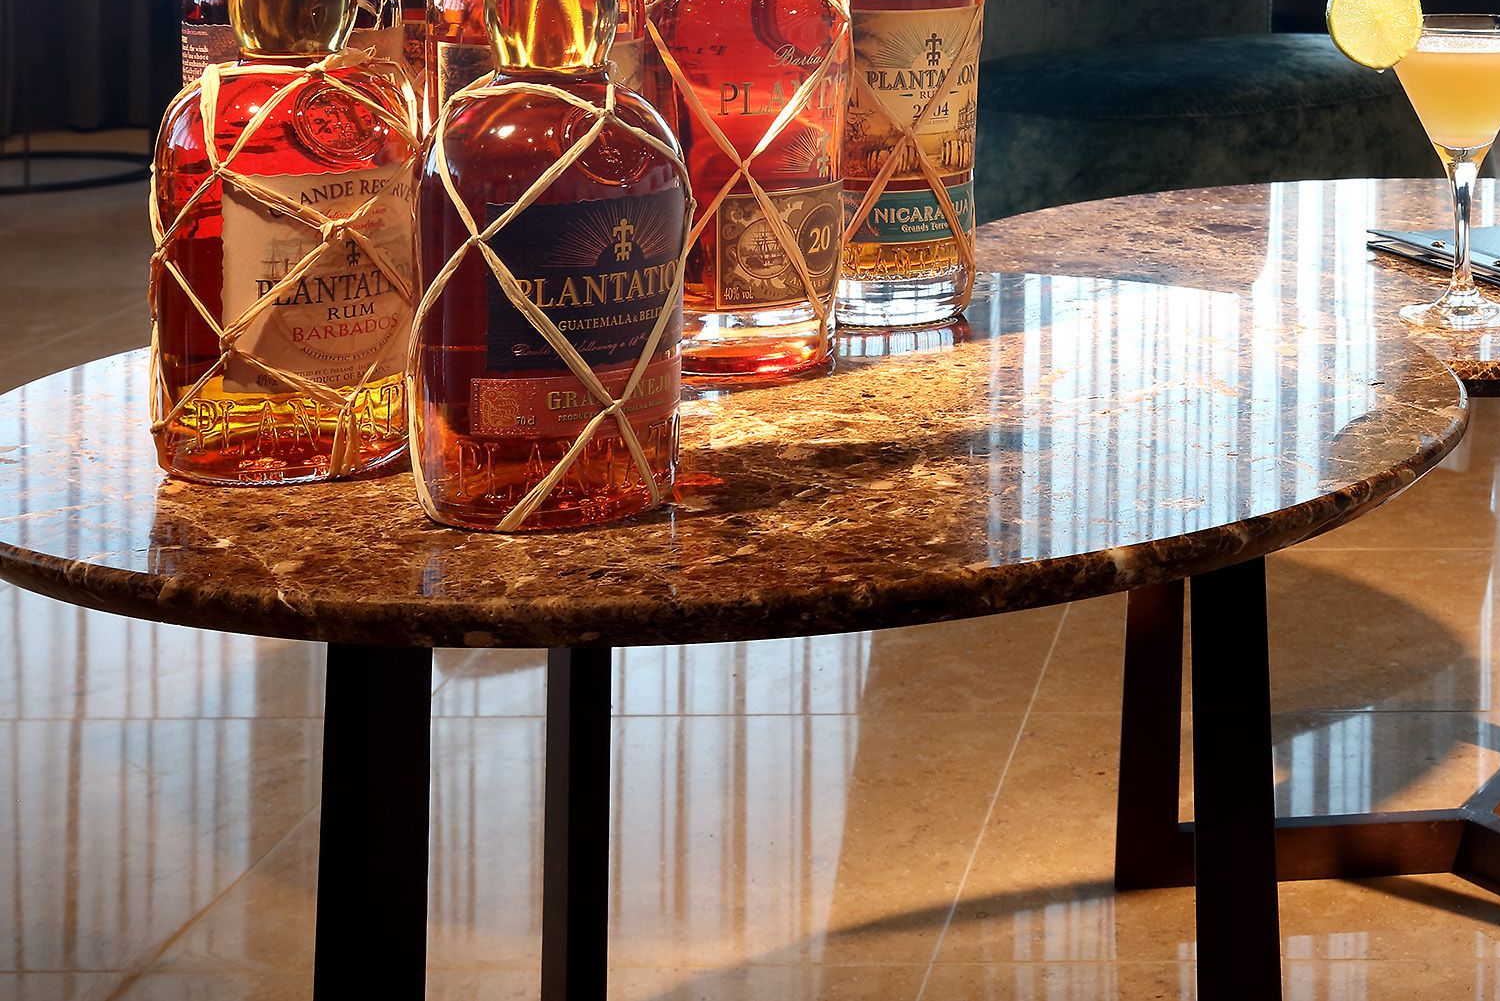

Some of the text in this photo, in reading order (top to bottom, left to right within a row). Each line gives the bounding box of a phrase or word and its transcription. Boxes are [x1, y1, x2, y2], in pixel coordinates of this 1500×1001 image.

[866, 63, 976, 91] PLANTAION
[874, 199, 969, 224] NICARAUA
[808, 225, 830, 254] 20
[513, 258, 681, 310] PLANTATIO
[327, 302, 375, 321] RUM
[292, 313, 399, 343] BARBADOS
